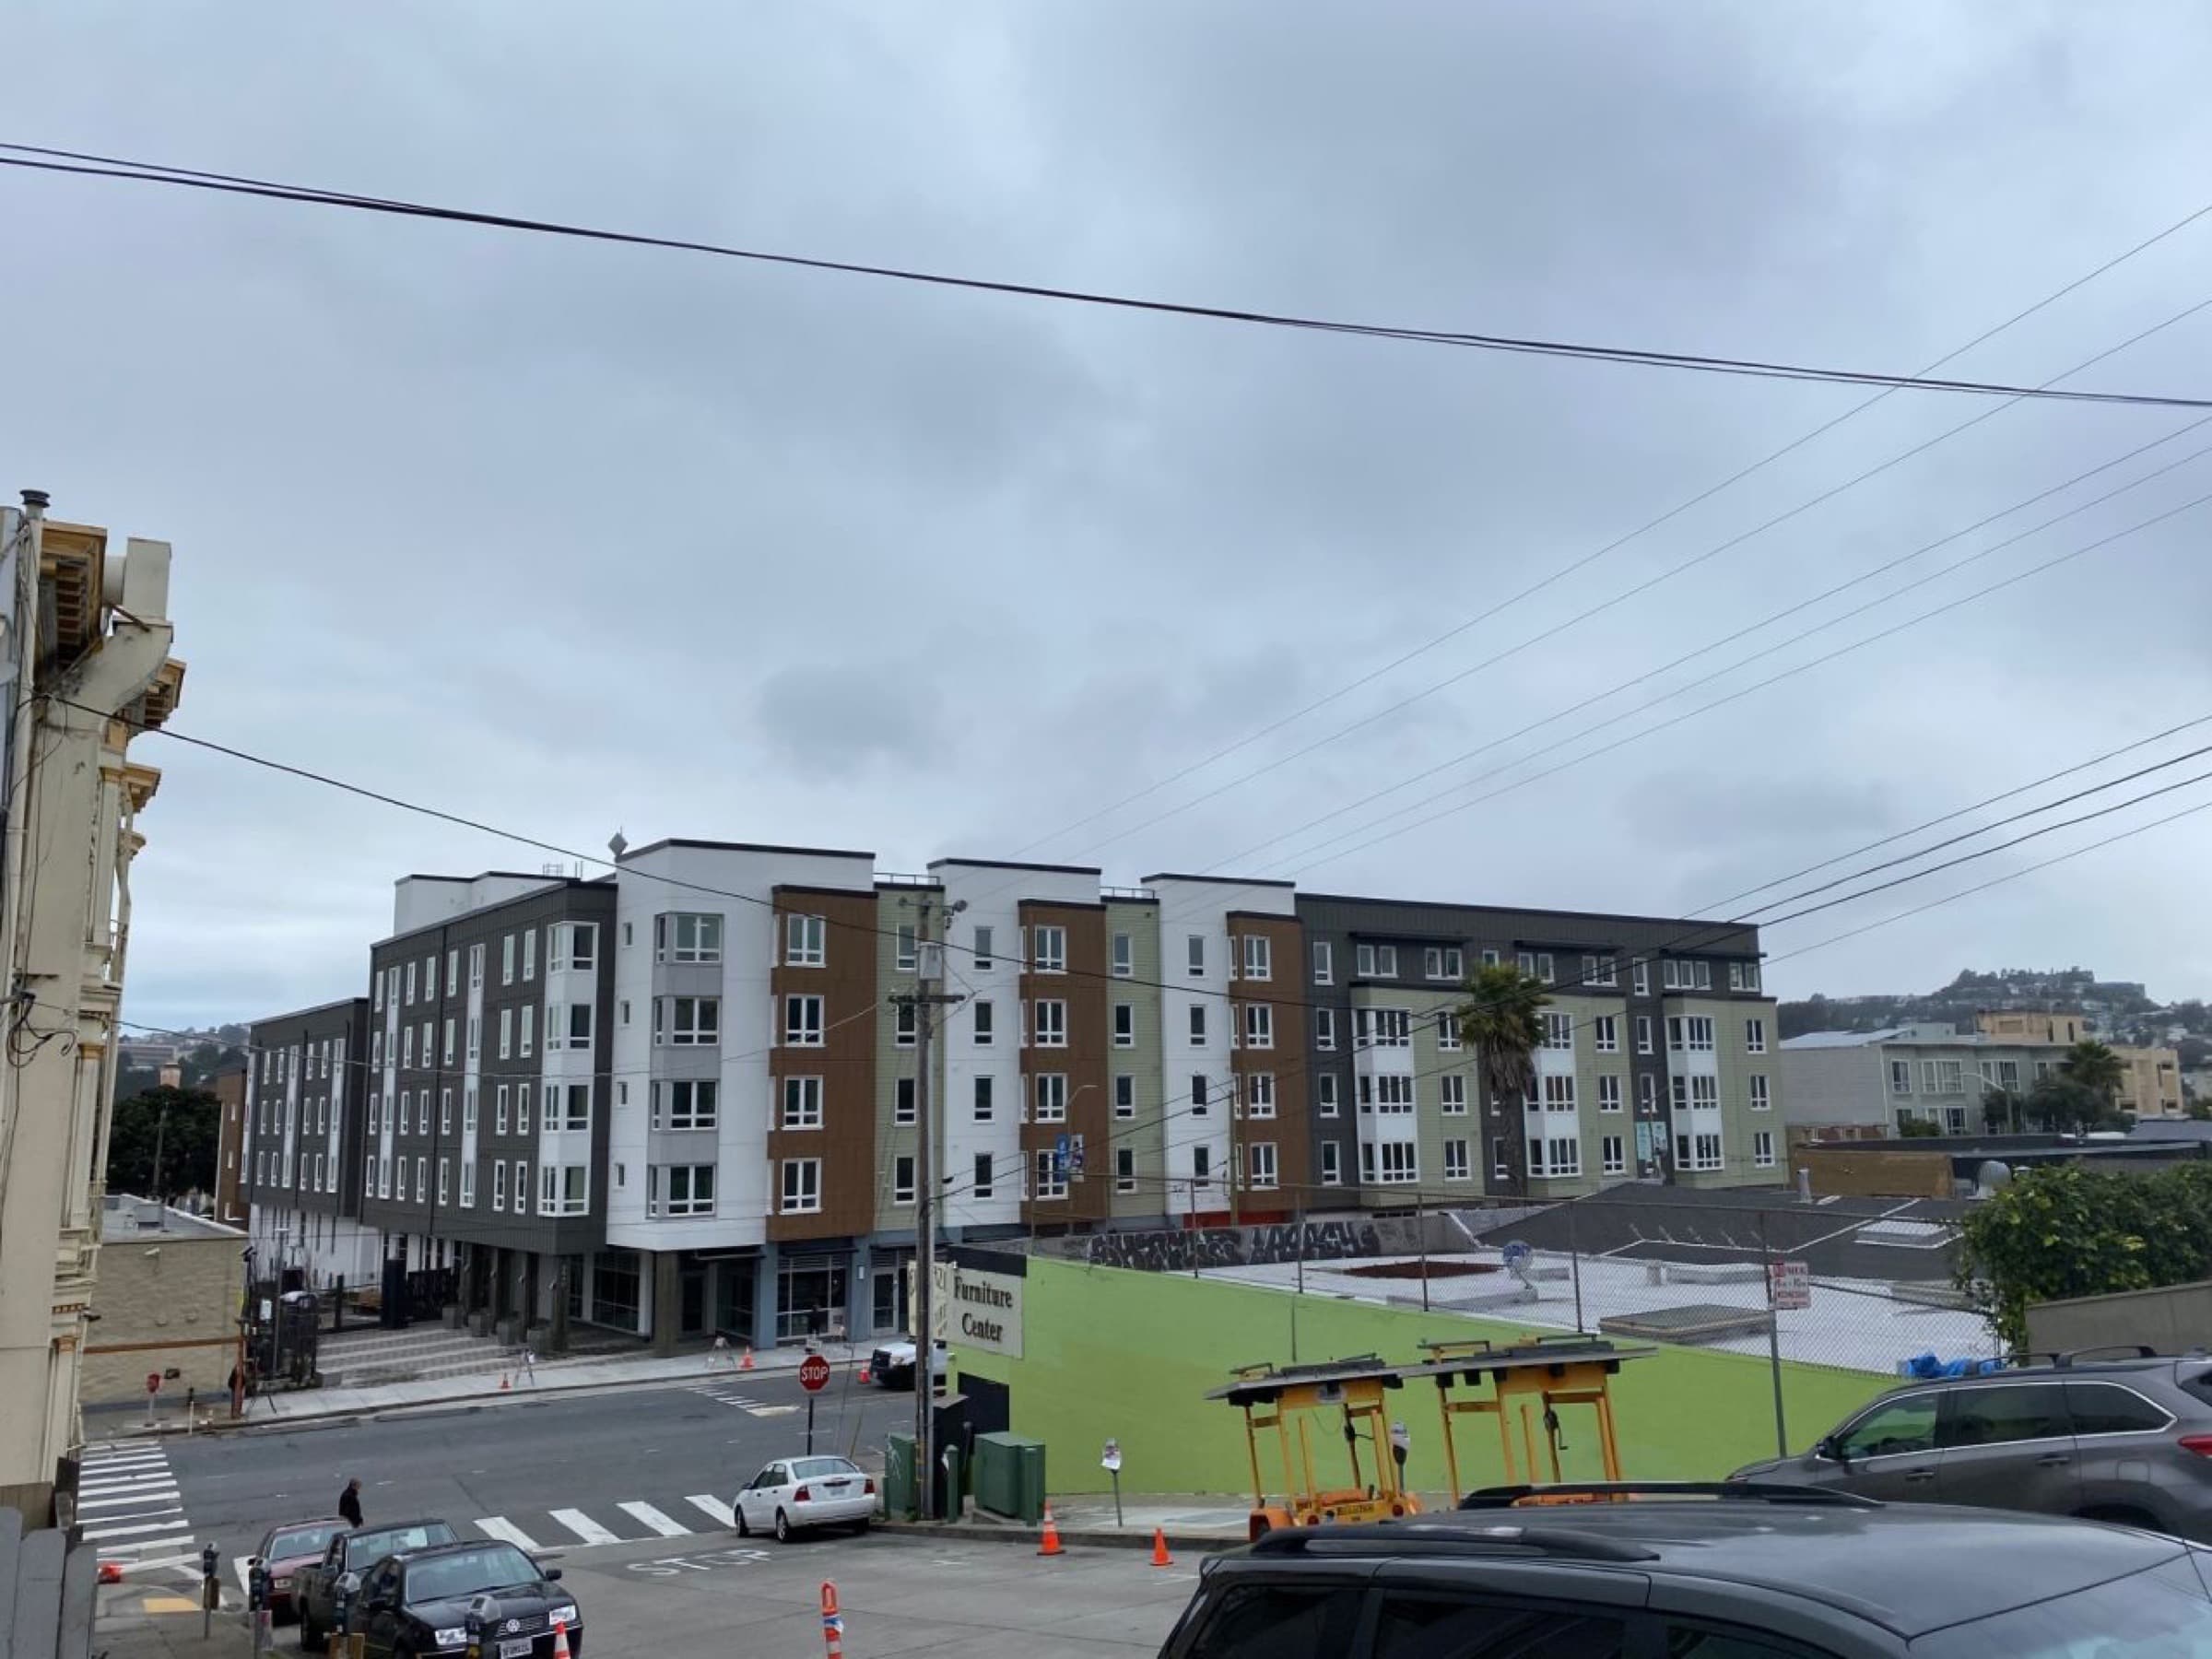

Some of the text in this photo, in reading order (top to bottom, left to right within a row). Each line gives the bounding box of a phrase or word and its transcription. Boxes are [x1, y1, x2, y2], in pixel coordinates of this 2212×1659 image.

[954, 1276, 1014, 1309] Furniture
[961, 1312, 1004, 1343] Center
[801, 1366, 829, 1382] STOP
[626, 1548, 771, 1575] STOP
